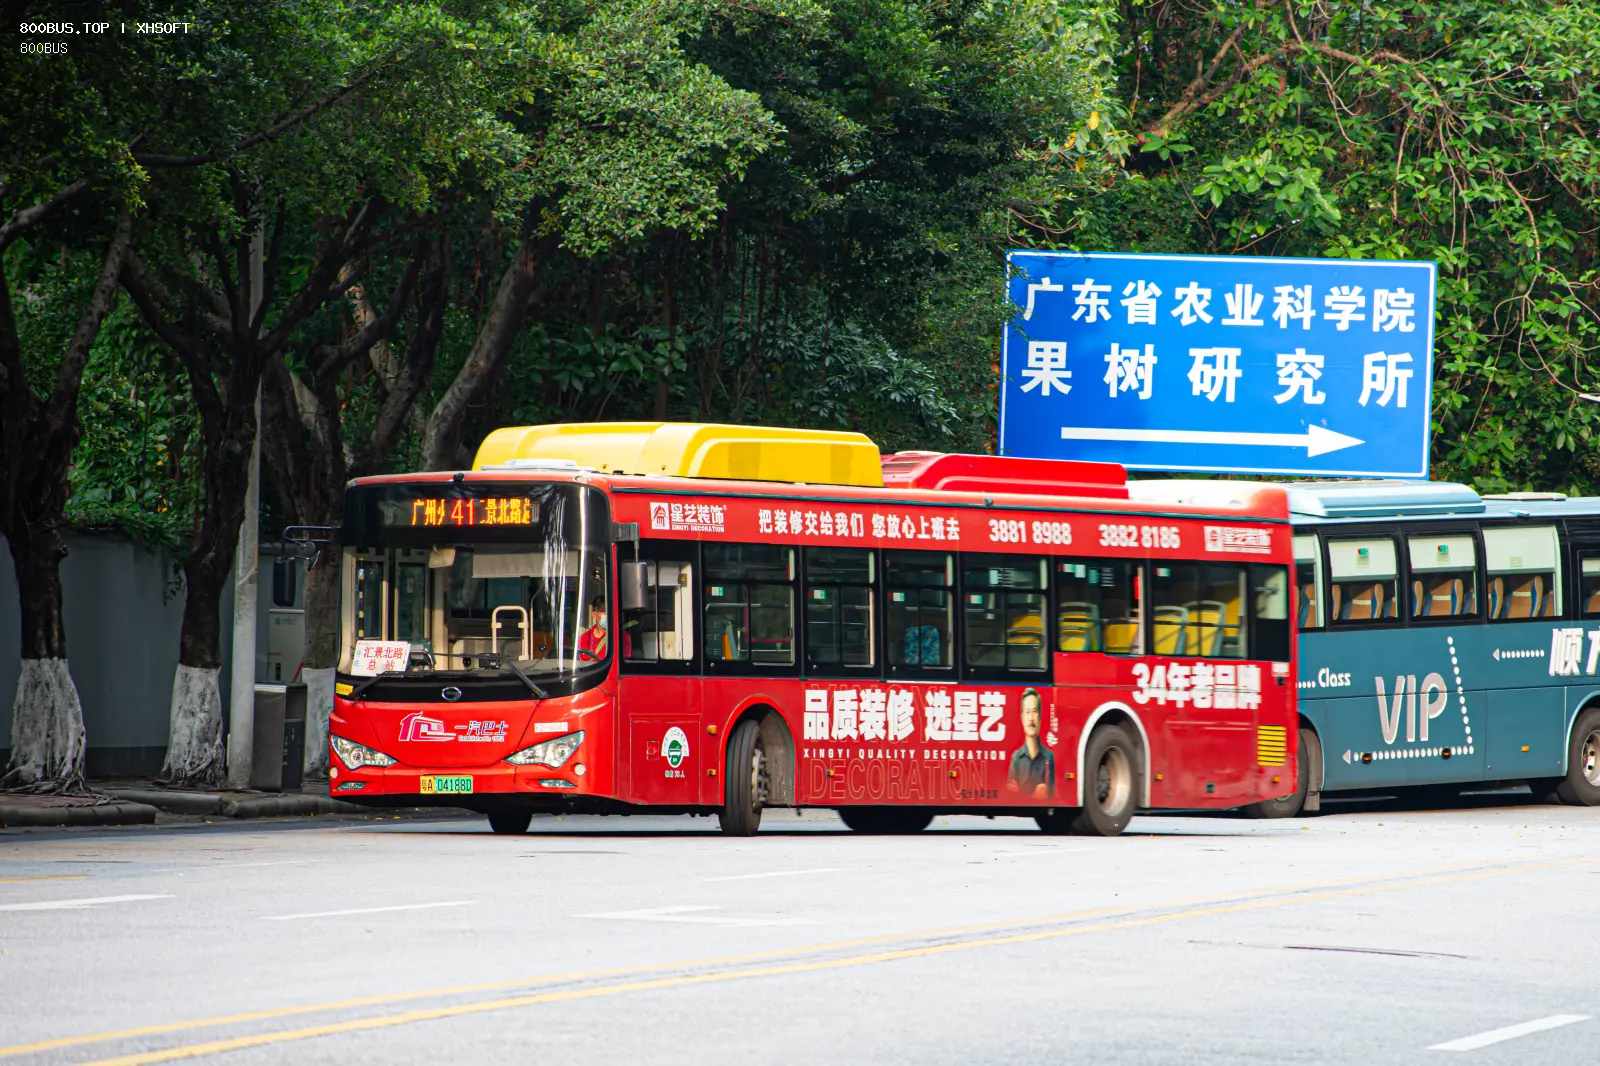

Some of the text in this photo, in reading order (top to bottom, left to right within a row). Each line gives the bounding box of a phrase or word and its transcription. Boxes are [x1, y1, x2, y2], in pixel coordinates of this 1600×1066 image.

[1022, 277, 1416, 333] 广东省农业科学院
[1020, 340, 1414, 408] 果树研究所
[670, 503, 724, 525] 星艺装饰
[758, 508, 961, 541] 把装修交给我们 您放心上班去
[690, 525, 725, 533] DECORATION
[988, 518, 1073, 545] 3881 8988
[1098, 523, 1181, 550] 3882 8186
[363, 646, 404, 660] 汇景北路
[367, 659, 396, 671] 总站
[1131, 661, 1262, 710] 34年老品牌
[1318, 667, 1351, 688] Class
[803, 688, 915, 741] 品质装修
[924, 690, 1007, 742] 选星艺
[1374, 672, 1448, 745] VIP
[454, 720, 509, 736] 一汽巴士
[804, 748, 1006, 761] XINGYI QUALITY DECORATION
[808, 758, 988, 801] DECORATION
